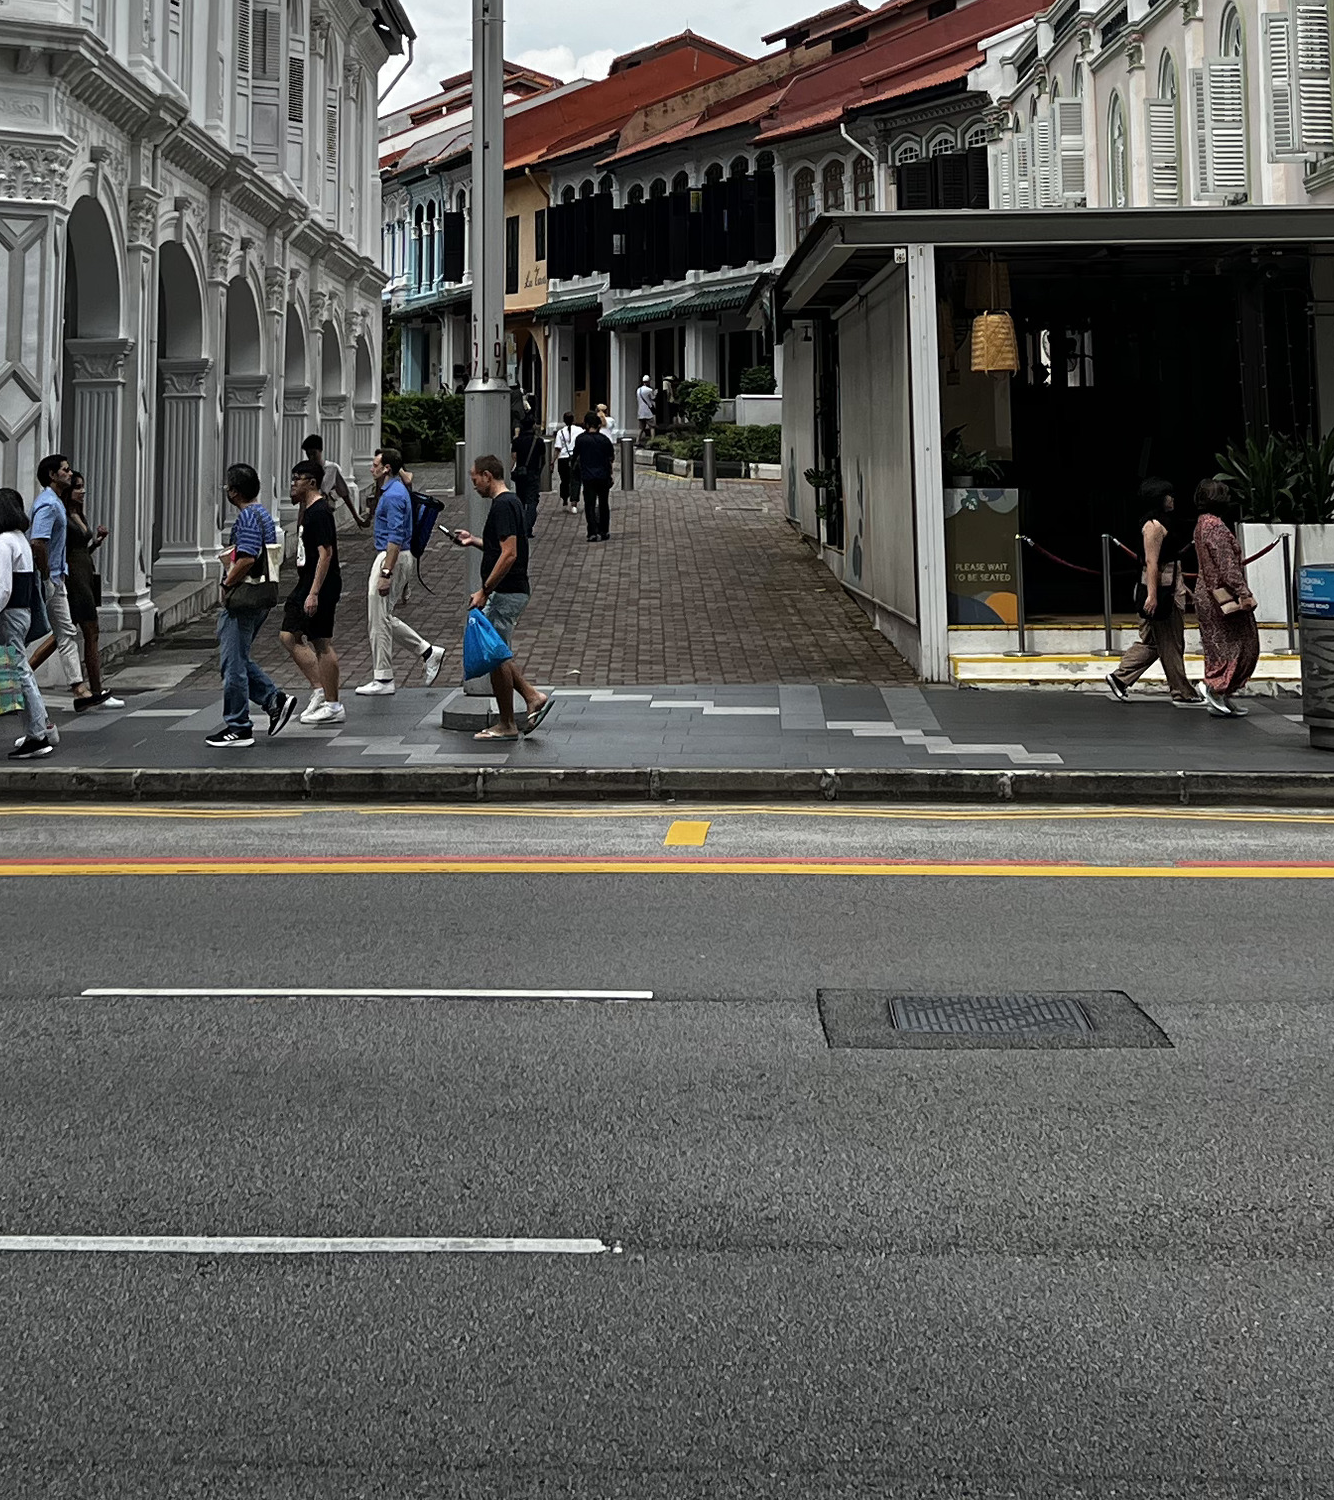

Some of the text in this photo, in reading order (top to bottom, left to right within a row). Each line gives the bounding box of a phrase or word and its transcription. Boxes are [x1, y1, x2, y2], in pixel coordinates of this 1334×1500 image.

[955, 563, 1008, 571] PLEASE WAIT
[954, 573, 1011, 582] TO BE SEATED
